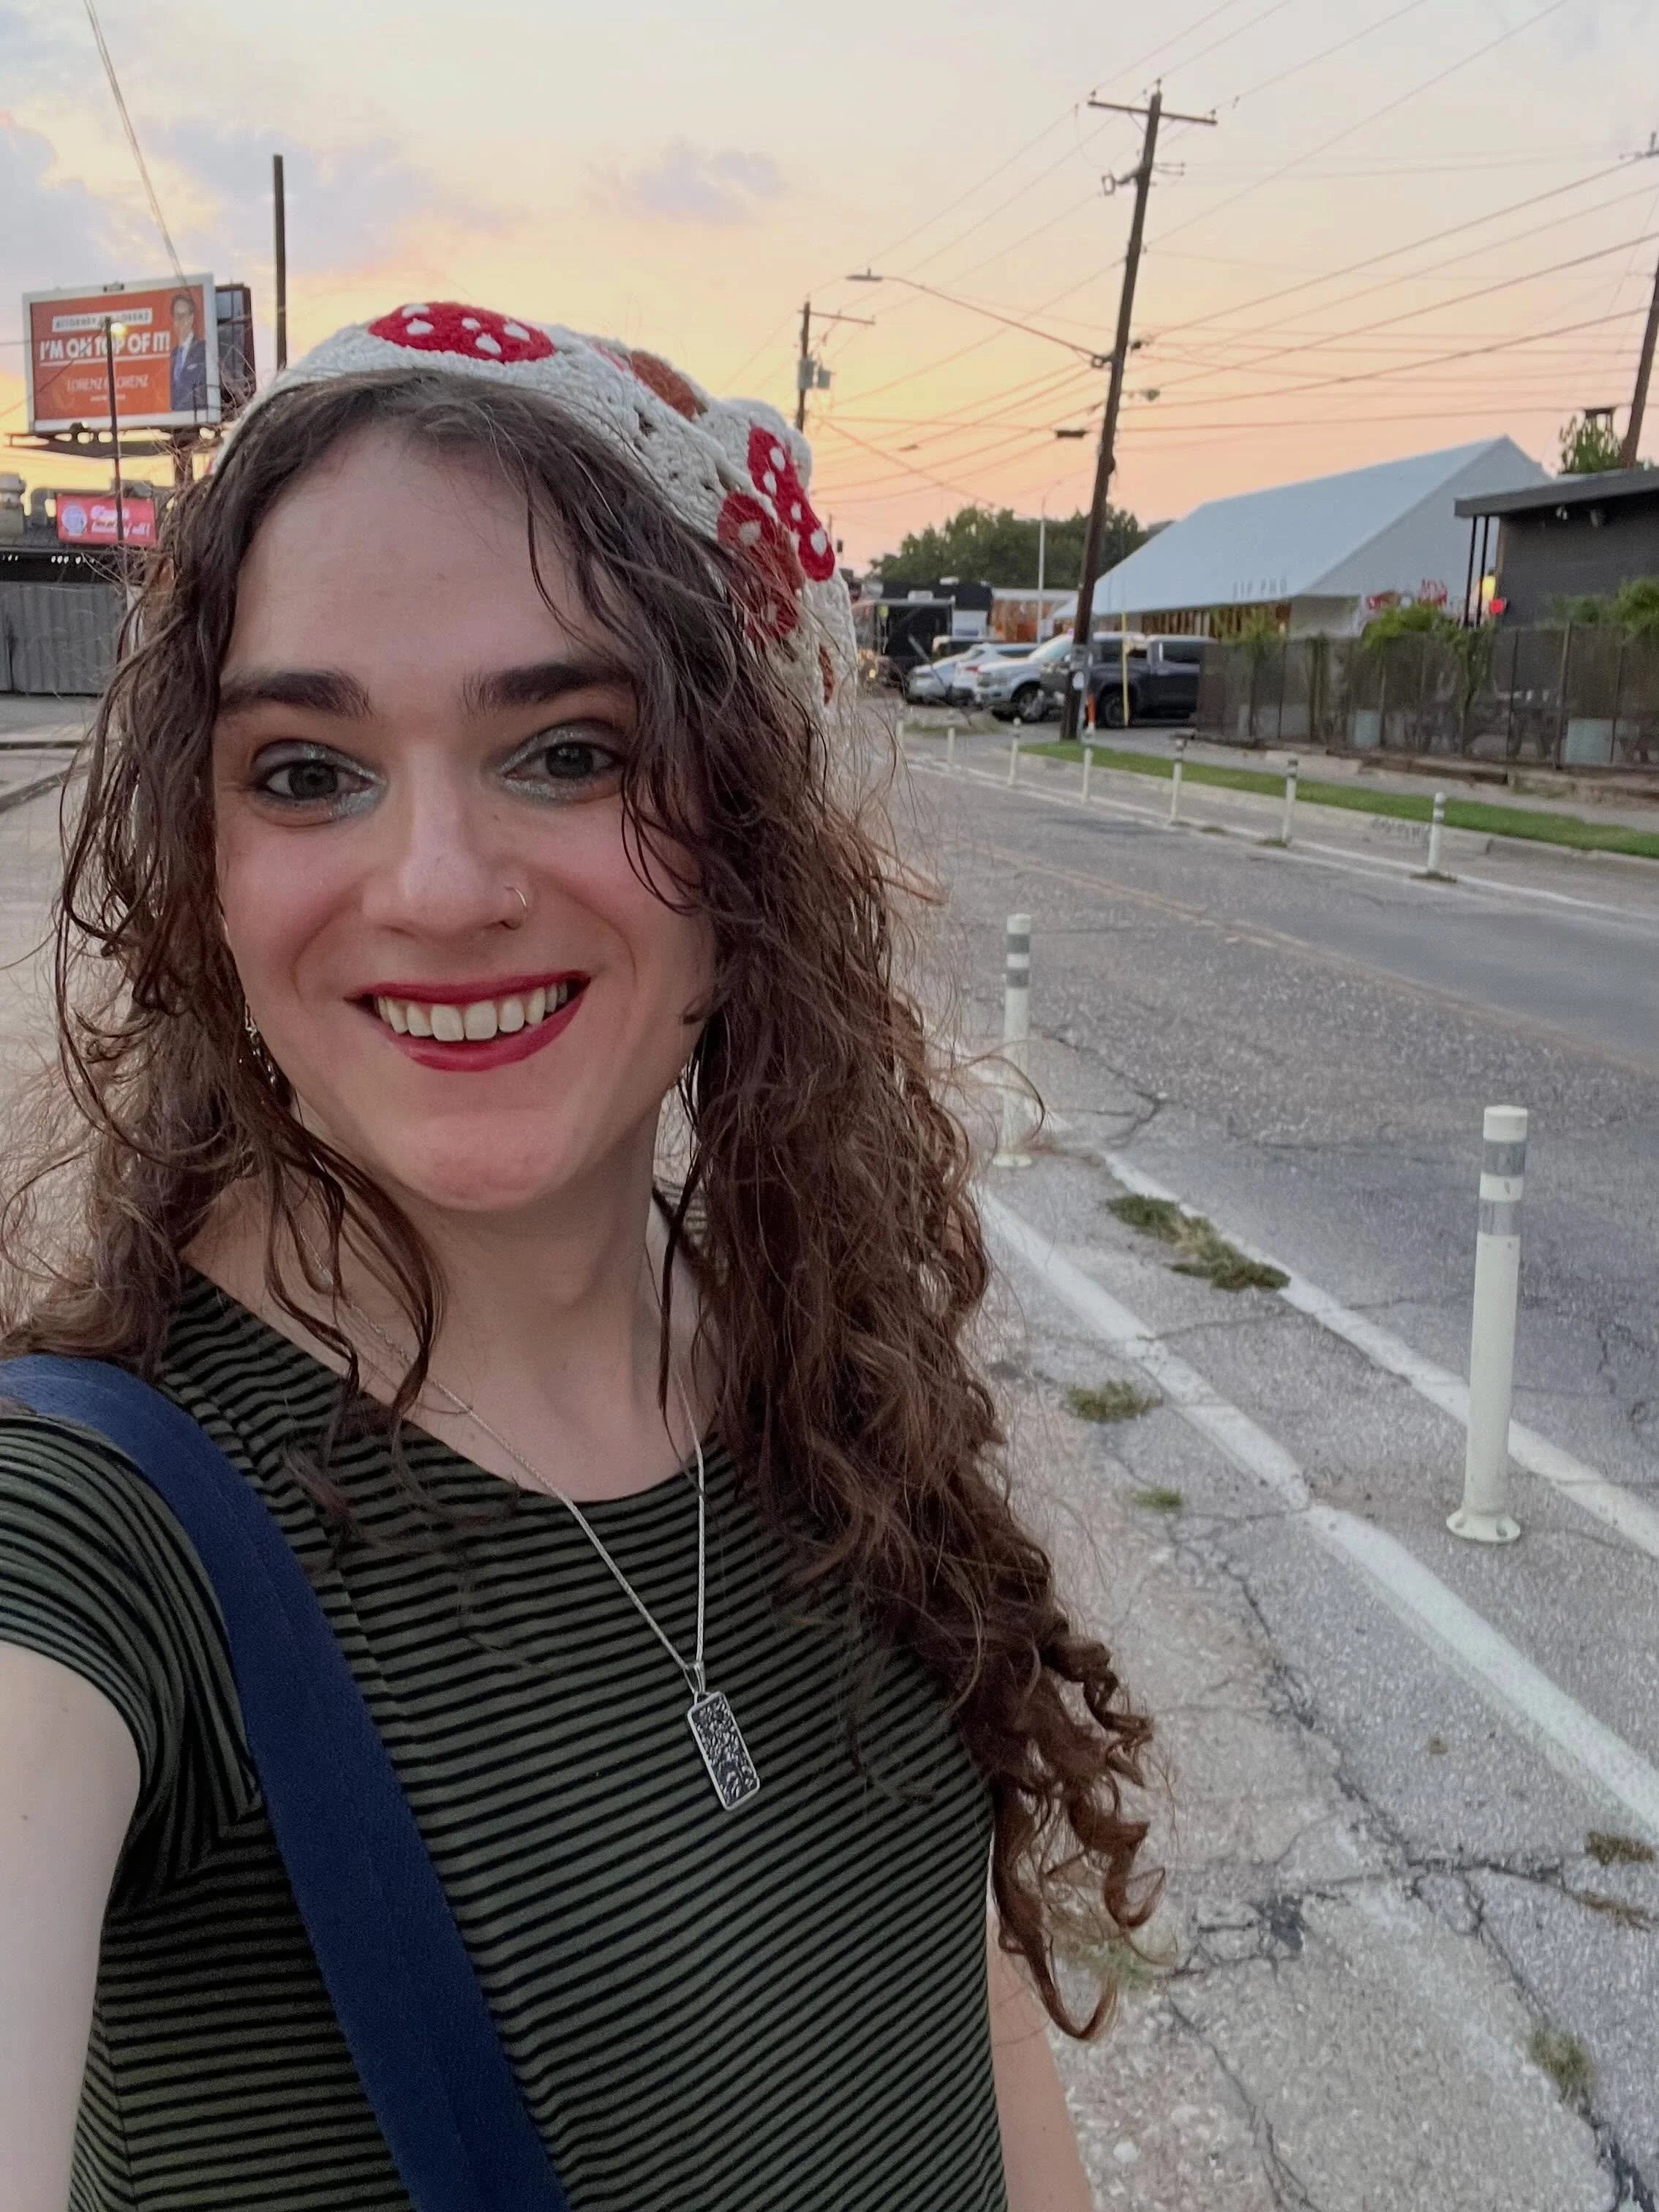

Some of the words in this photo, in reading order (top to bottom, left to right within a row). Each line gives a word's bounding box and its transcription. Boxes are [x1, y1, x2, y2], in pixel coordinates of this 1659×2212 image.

[40, 340, 64, 361] I'M
[67, 337, 92, 358] ON
[127, 332, 151, 354] OF
